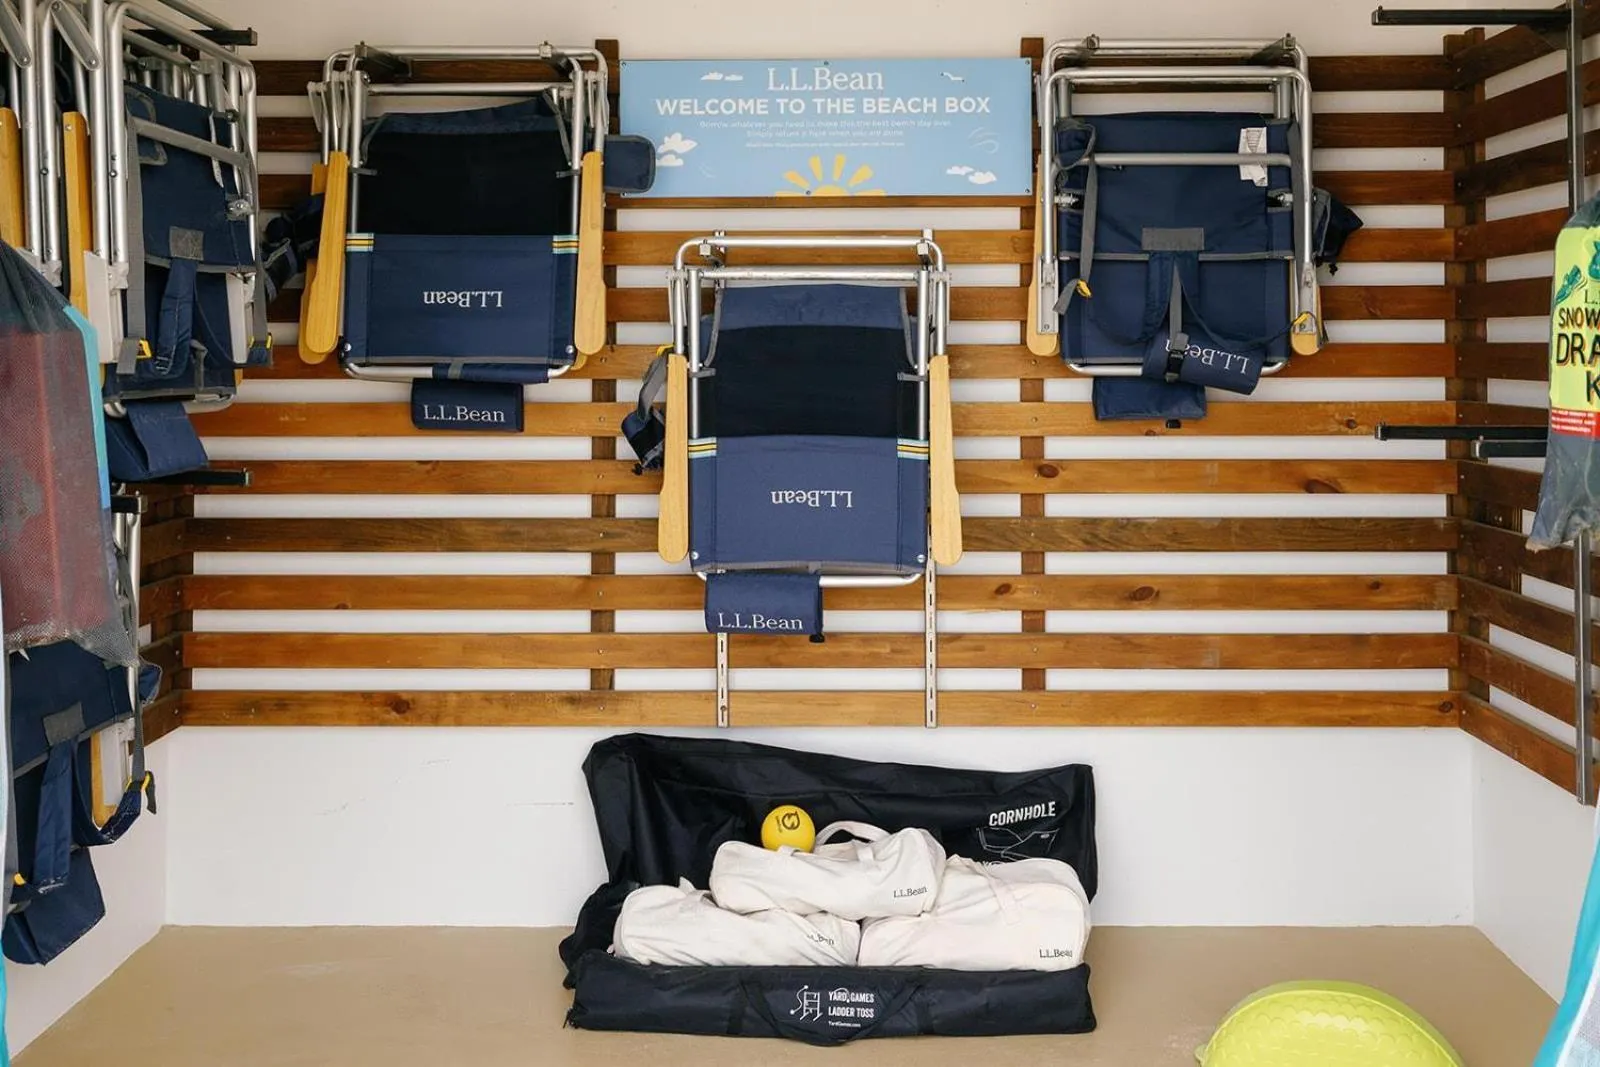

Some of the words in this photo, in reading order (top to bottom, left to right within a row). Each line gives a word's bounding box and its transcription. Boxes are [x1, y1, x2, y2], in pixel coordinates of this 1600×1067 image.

[767, 67, 884, 91] L.L.Bean
[656, 98, 771, 116] WELCOME
[776, 98, 805, 115] TO
[812, 97, 855, 115] THE
[863, 96, 937, 115] BEACH
[945, 95, 991, 114] BOX
[423, 291, 503, 307] L.L.Bean
[424, 404, 506, 423] L.L.Bean
[770, 491, 853, 508] L.L.Bean
[718, 612, 804, 630] L.L.Bean
[989, 801, 1056, 827] CORNHOLE
[893, 886, 928, 898] L.L.Bean
[828, 991, 847, 1002] YARD
[850, 992, 875, 1003] GAMES
[828, 1006, 855, 1017] LADDER
[856, 1007, 875, 1018] TOSS
